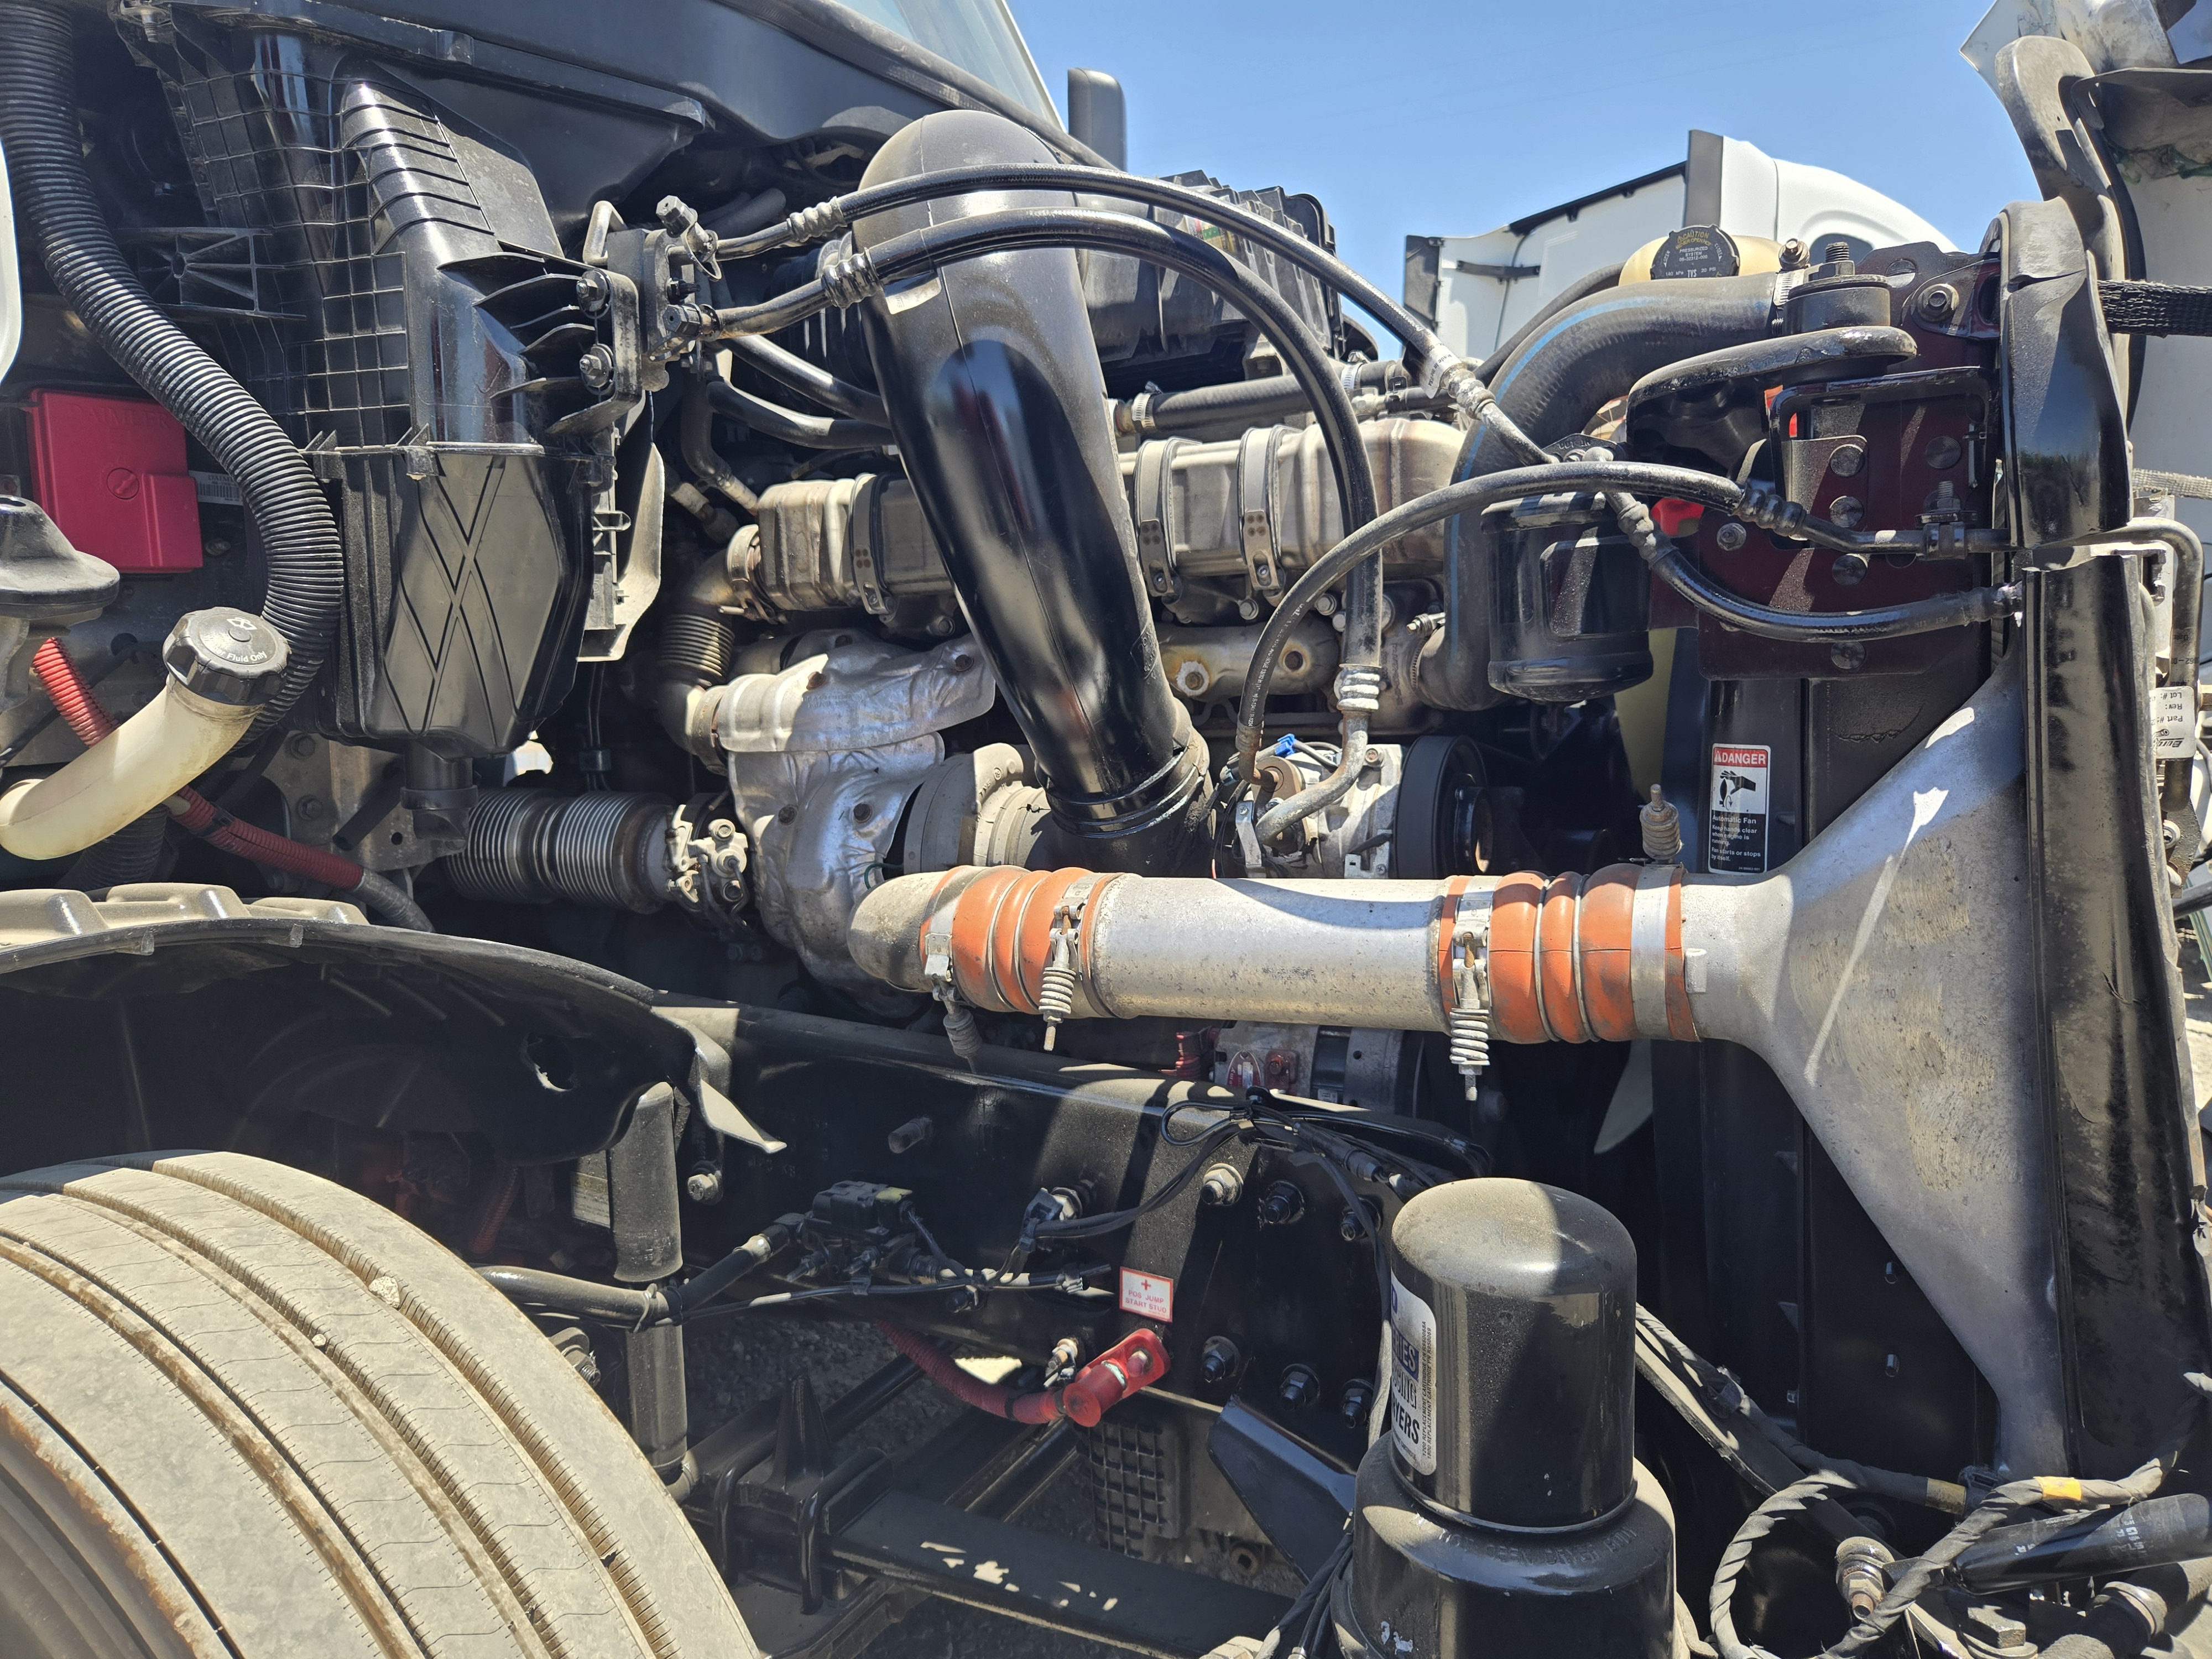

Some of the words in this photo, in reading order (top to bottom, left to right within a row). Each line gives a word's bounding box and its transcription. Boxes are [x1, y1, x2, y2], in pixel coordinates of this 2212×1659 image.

[1682, 230, 1709, 239] CAUTION
[1687, 269, 1697, 278] TVS
[226, 653, 249, 662] Fluid
[250, 651, 268, 661] Only
[1722, 752, 1766, 765] DANGER
[1712, 815, 1741, 823] Automatic
[1128, 1290, 1142, 1299] POS
[1145, 1295, 1164, 1303] JUMP
[1125, 1297, 1147, 1308] START
[1149, 1303, 1167, 1313] STUD
[1422, 1353, 1427, 1361] PN
